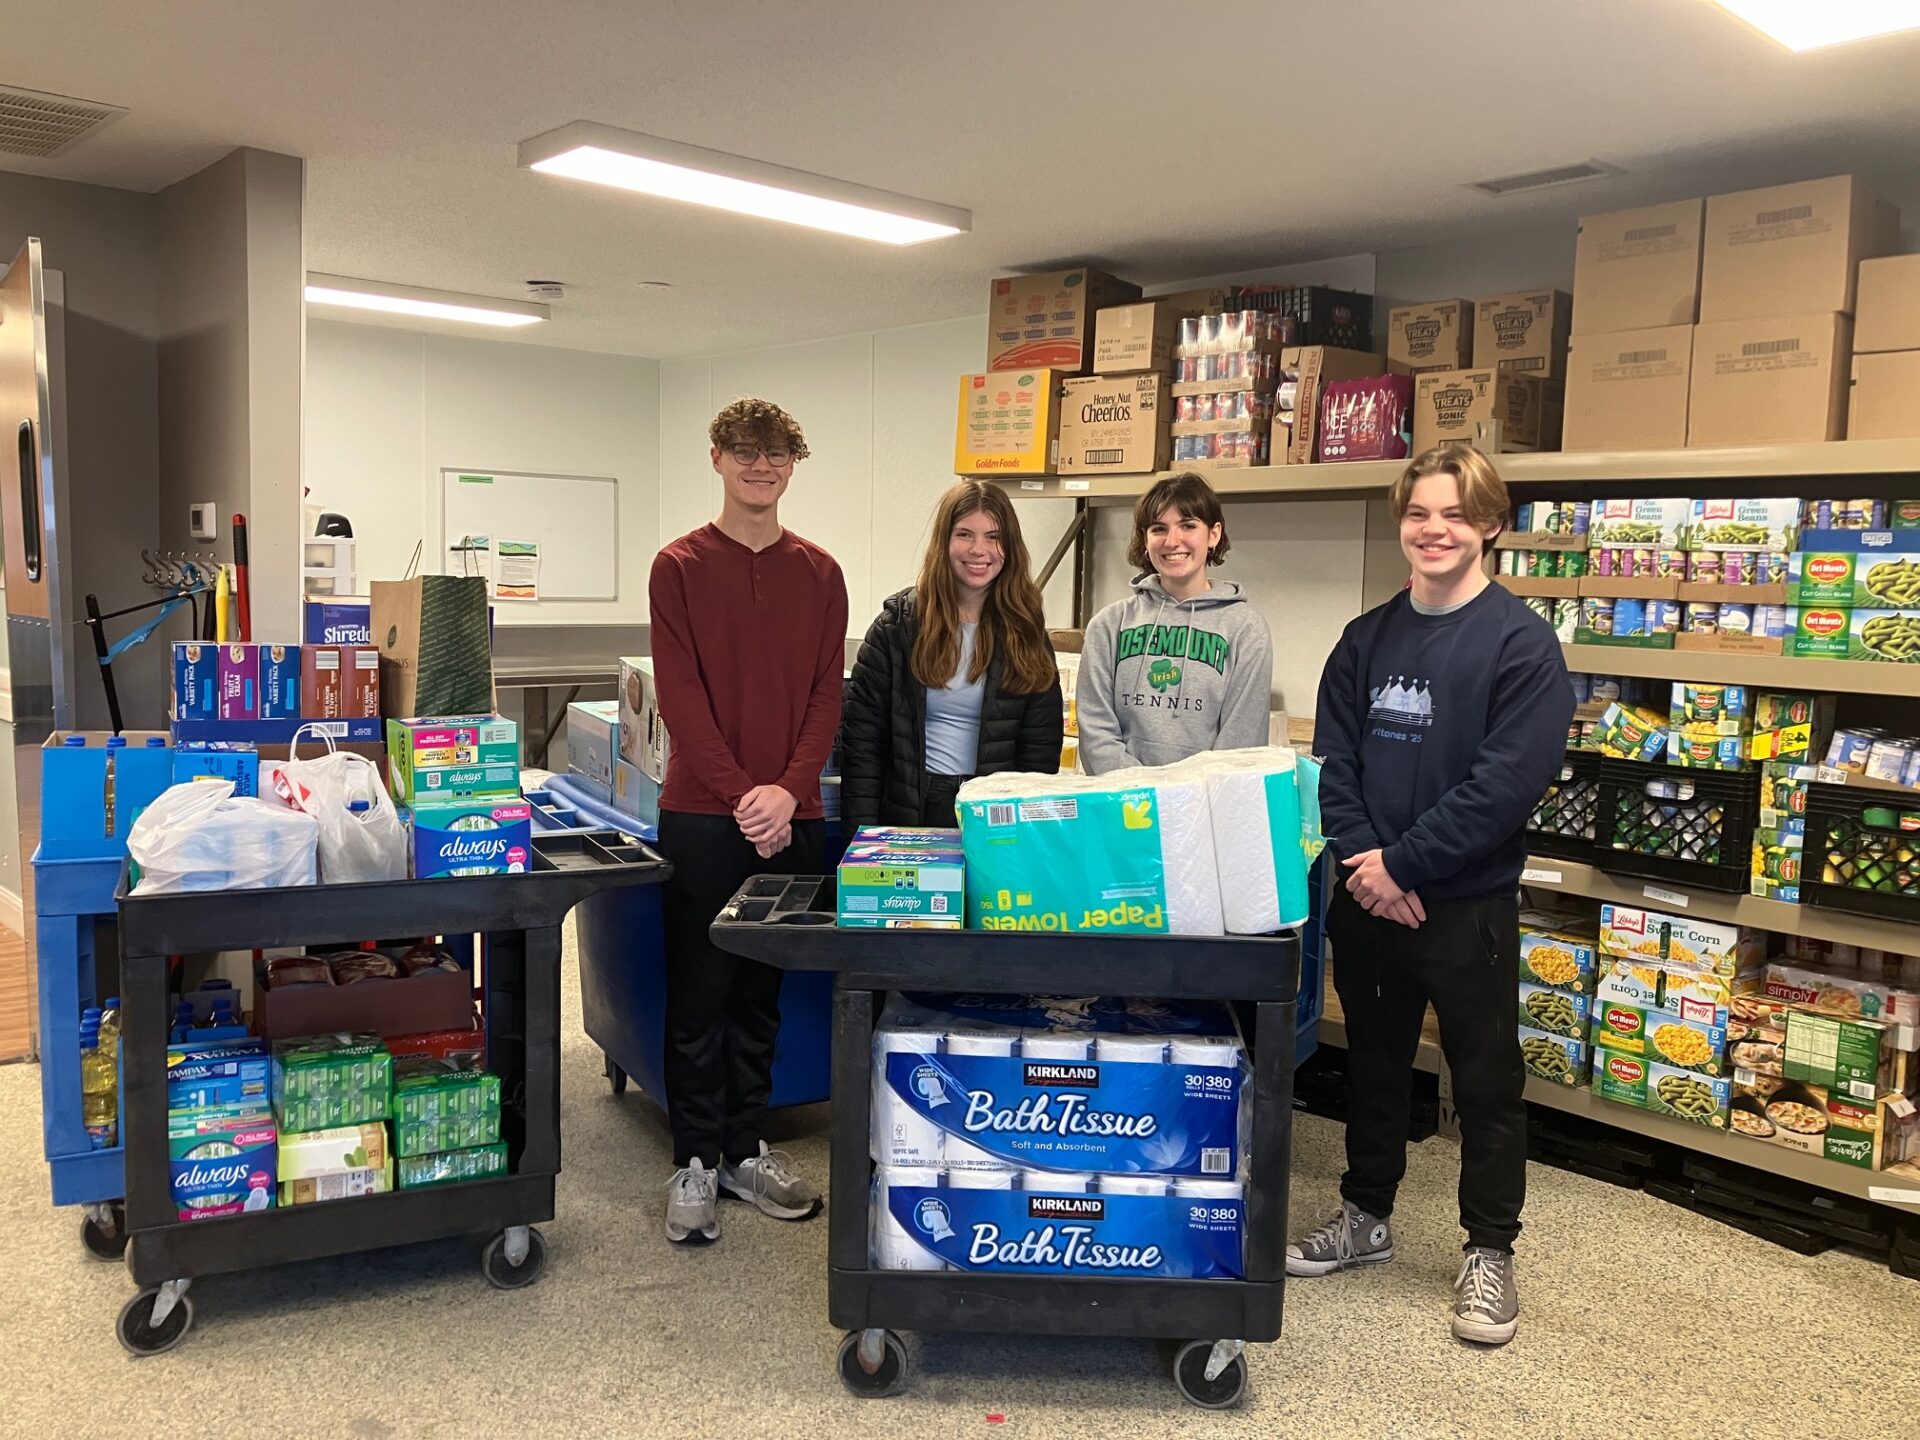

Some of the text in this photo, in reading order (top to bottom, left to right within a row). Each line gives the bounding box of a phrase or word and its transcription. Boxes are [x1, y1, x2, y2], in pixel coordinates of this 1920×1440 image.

[1495, 318, 1531, 329] TREATS
[1407, 327, 1440, 339] TREATS
[1498, 332, 1525, 341] SONIC
[1409, 341, 1434, 350] SONIC
[1093, 393, 1132, 405] Honey Nut
[1302, 378, 1313, 415] IODIZED
[1436, 397, 1472, 409] TREATS
[1081, 404, 1132, 423] Cheerios
[1438, 412, 1465, 420] SONIC
[1300, 417, 1310, 439] SALT
[976, 457, 1020, 469] Golden Foods
[1067, 457, 1072, 466] 4
[1635, 505, 1663, 513] Green
[1737, 506, 1768, 514] Green
[1737, 513, 1768, 522] Beans
[1810, 564, 1846, 573] Del Monte
[1806, 617, 1843, 626] Del Monte
[1116, 623, 1230, 676] OSEMOUNT
[1152, 670, 1178, 682] Irish
[188, 681, 196, 706] VARIETY
[1729, 689, 1738, 698] 8
[1122, 693, 1204, 712] TENNIS
[1409, 731, 1422, 743] '25
[1652, 736, 1660, 745] 8
[1786, 732, 1794, 748] CAN
[1794, 732, 1807, 743] 4
[1724, 743, 1732, 751] 8
[449, 771, 483, 785] always
[440, 835, 507, 860] always
[882, 895, 922, 912] always
[981, 901, 994, 909] 150
[1078, 900, 1163, 929] Paper
[1617, 914, 1640, 926] Libby's
[1688, 931, 1721, 946] Corn
[1577, 950, 1585, 959] 8
[1610, 983, 1639, 998] Corn
[1768, 985, 1812, 1002] simply
[1576, 997, 1583, 1006] 8
[1686, 1005, 1709, 1018] Libby's
[1609, 1013, 1639, 1027] Del Monte
[1711, 1030, 1720, 1040] 8
[1569, 1044, 1576, 1053] 8
[167, 1065, 207, 1080] TAMPAX
[1028, 1065, 1097, 1080] KIRKLAND
[1611, 1063, 1641, 1076] Del Monte
[1184, 1074, 1232, 1089] 30 380
[1716, 1083, 1724, 1092] 8
[1205, 1092, 1232, 1100] SHEETS
[964, 1090, 1157, 1137] Bath Tissue
[1011, 1141, 1107, 1153] Soft and Absorbent
[1802, 1142, 1809, 1150] 8
[1830, 1145, 1871, 1161] Marie
[174, 1164, 249, 1188] always
[184, 1185, 206, 1193] ULTRA
[1032, 1198, 1102, 1213] KIRKLAND
[1189, 1206, 1237, 1220] 30 380
[969, 1223, 1161, 1268] Bath Tissue
